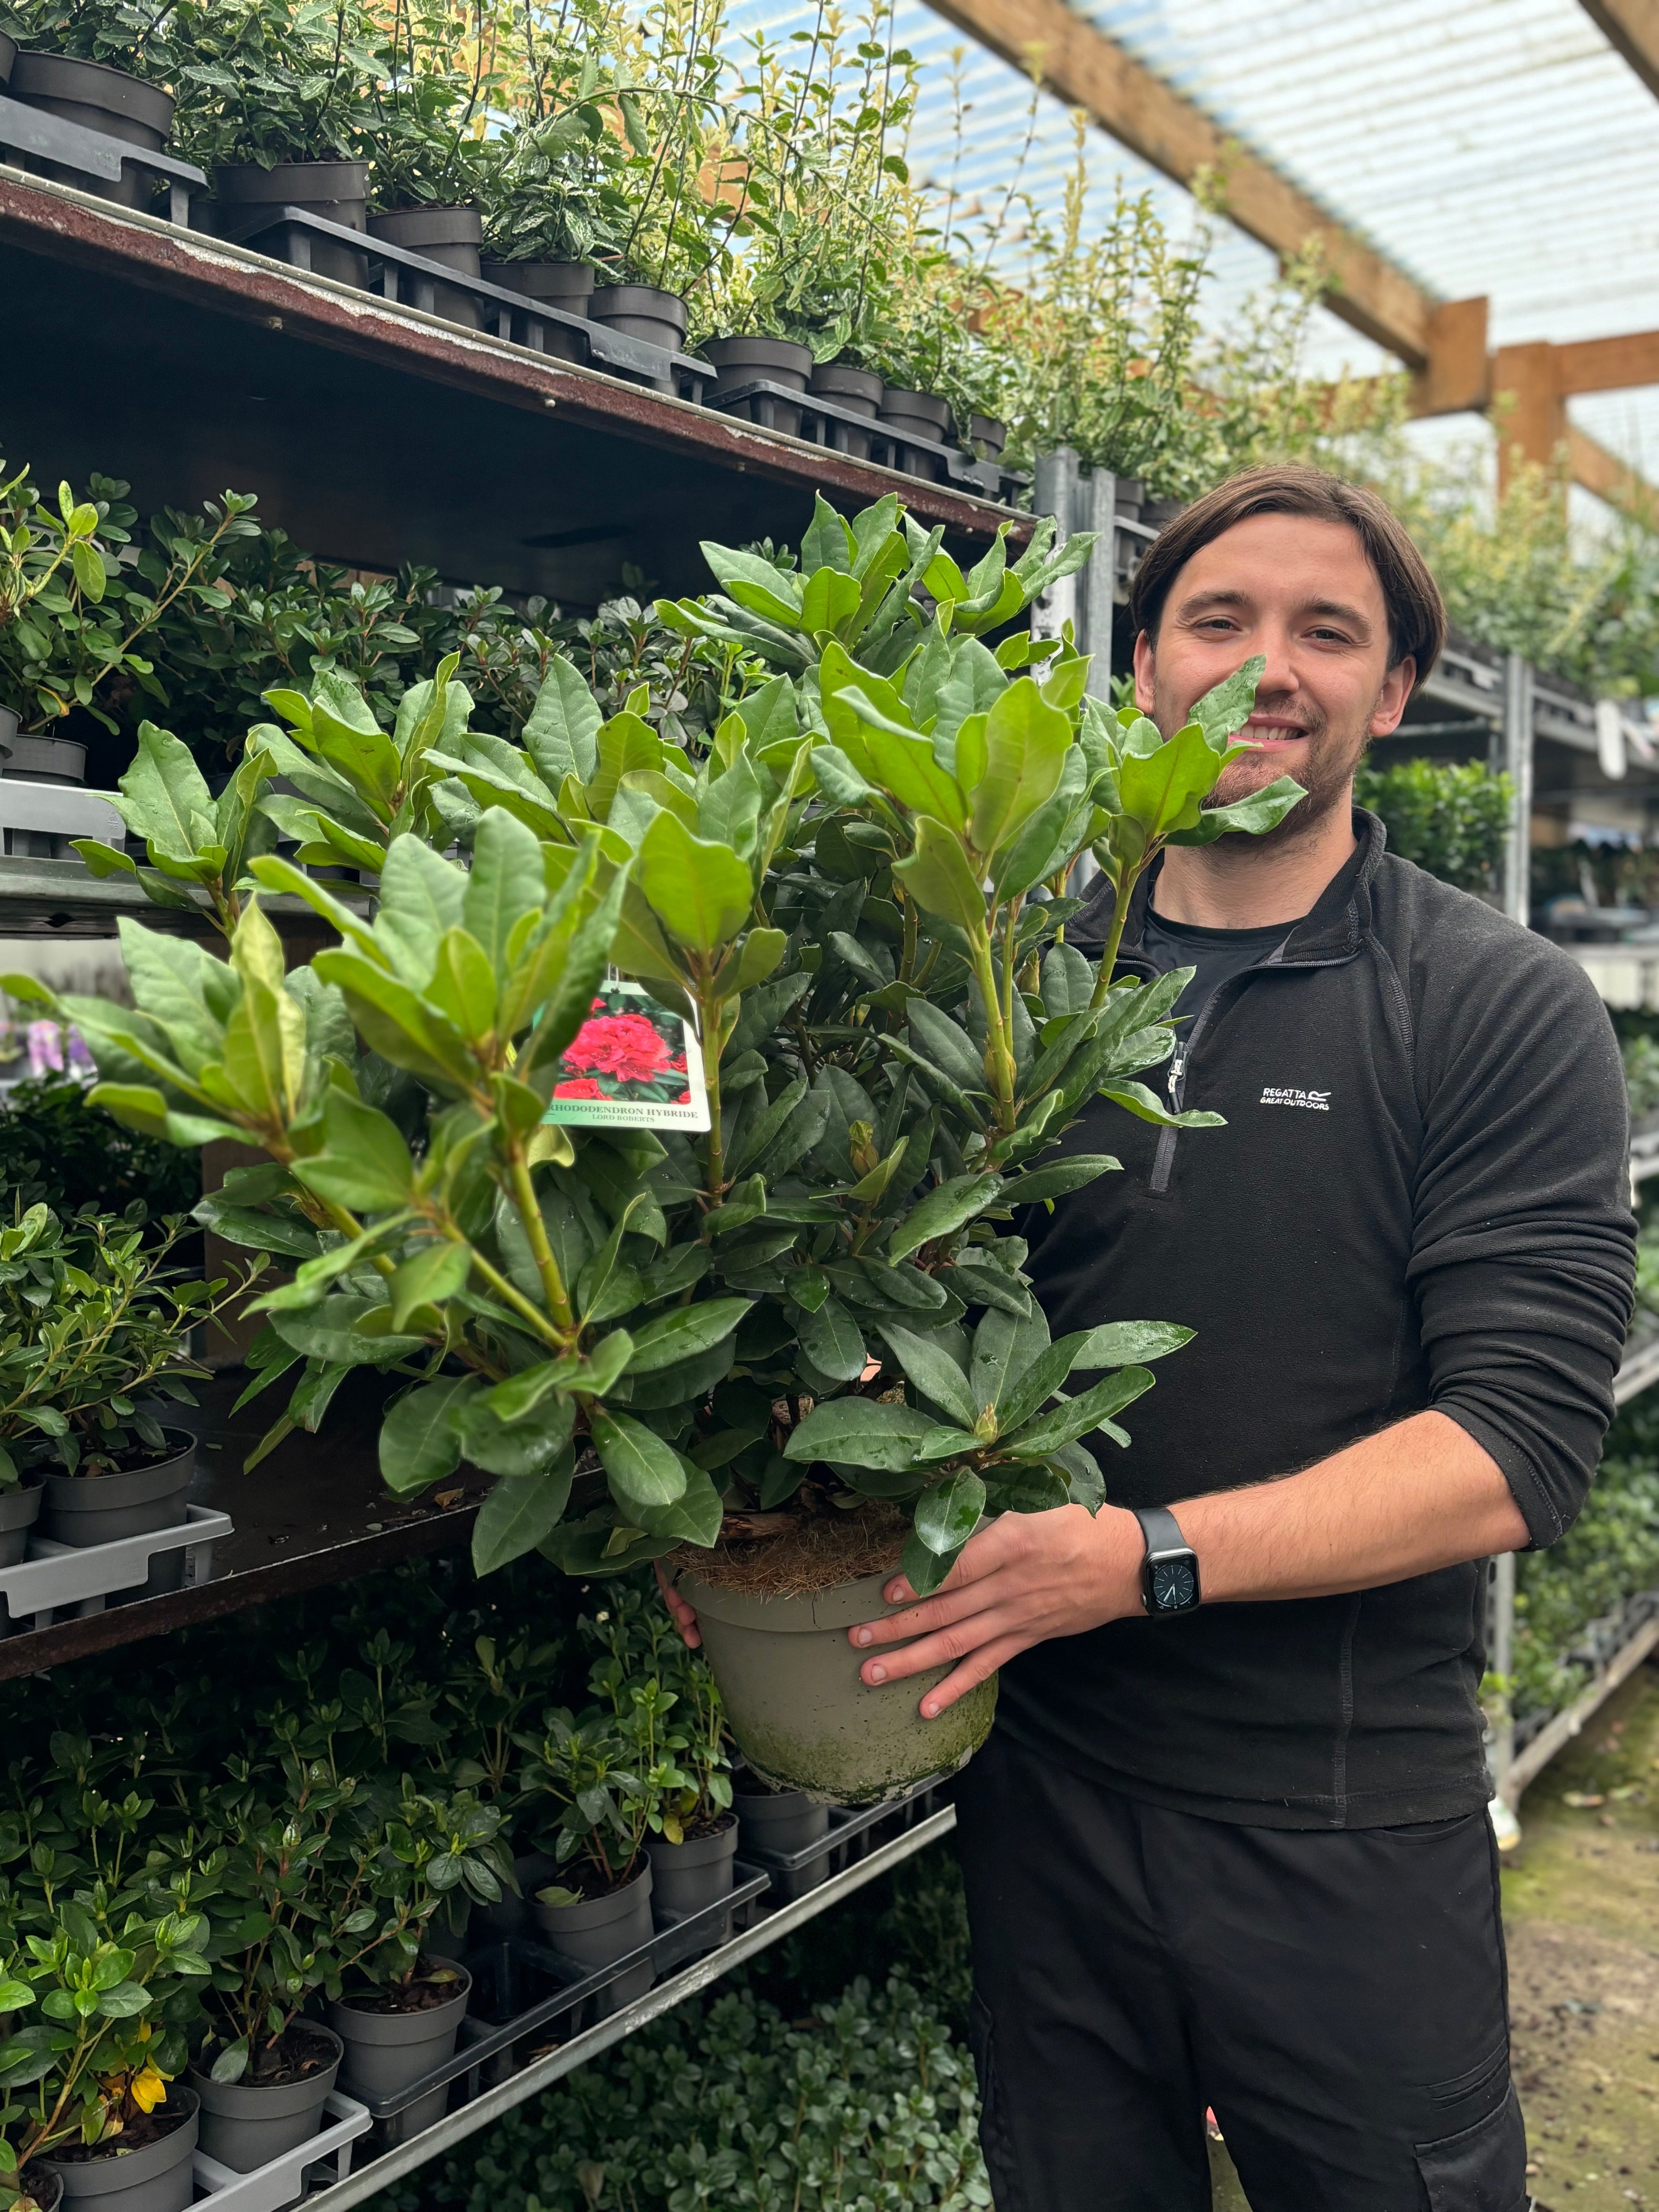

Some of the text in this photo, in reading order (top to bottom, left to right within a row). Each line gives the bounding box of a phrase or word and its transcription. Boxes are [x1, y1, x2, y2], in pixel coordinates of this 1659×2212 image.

[1263, 1087, 1306, 1099] REGATTA
[1260, 1096, 1329, 1111] GREAT OUTDOORS
[548, 1104, 698, 1119] RHODODENDRON HYBRIDE
